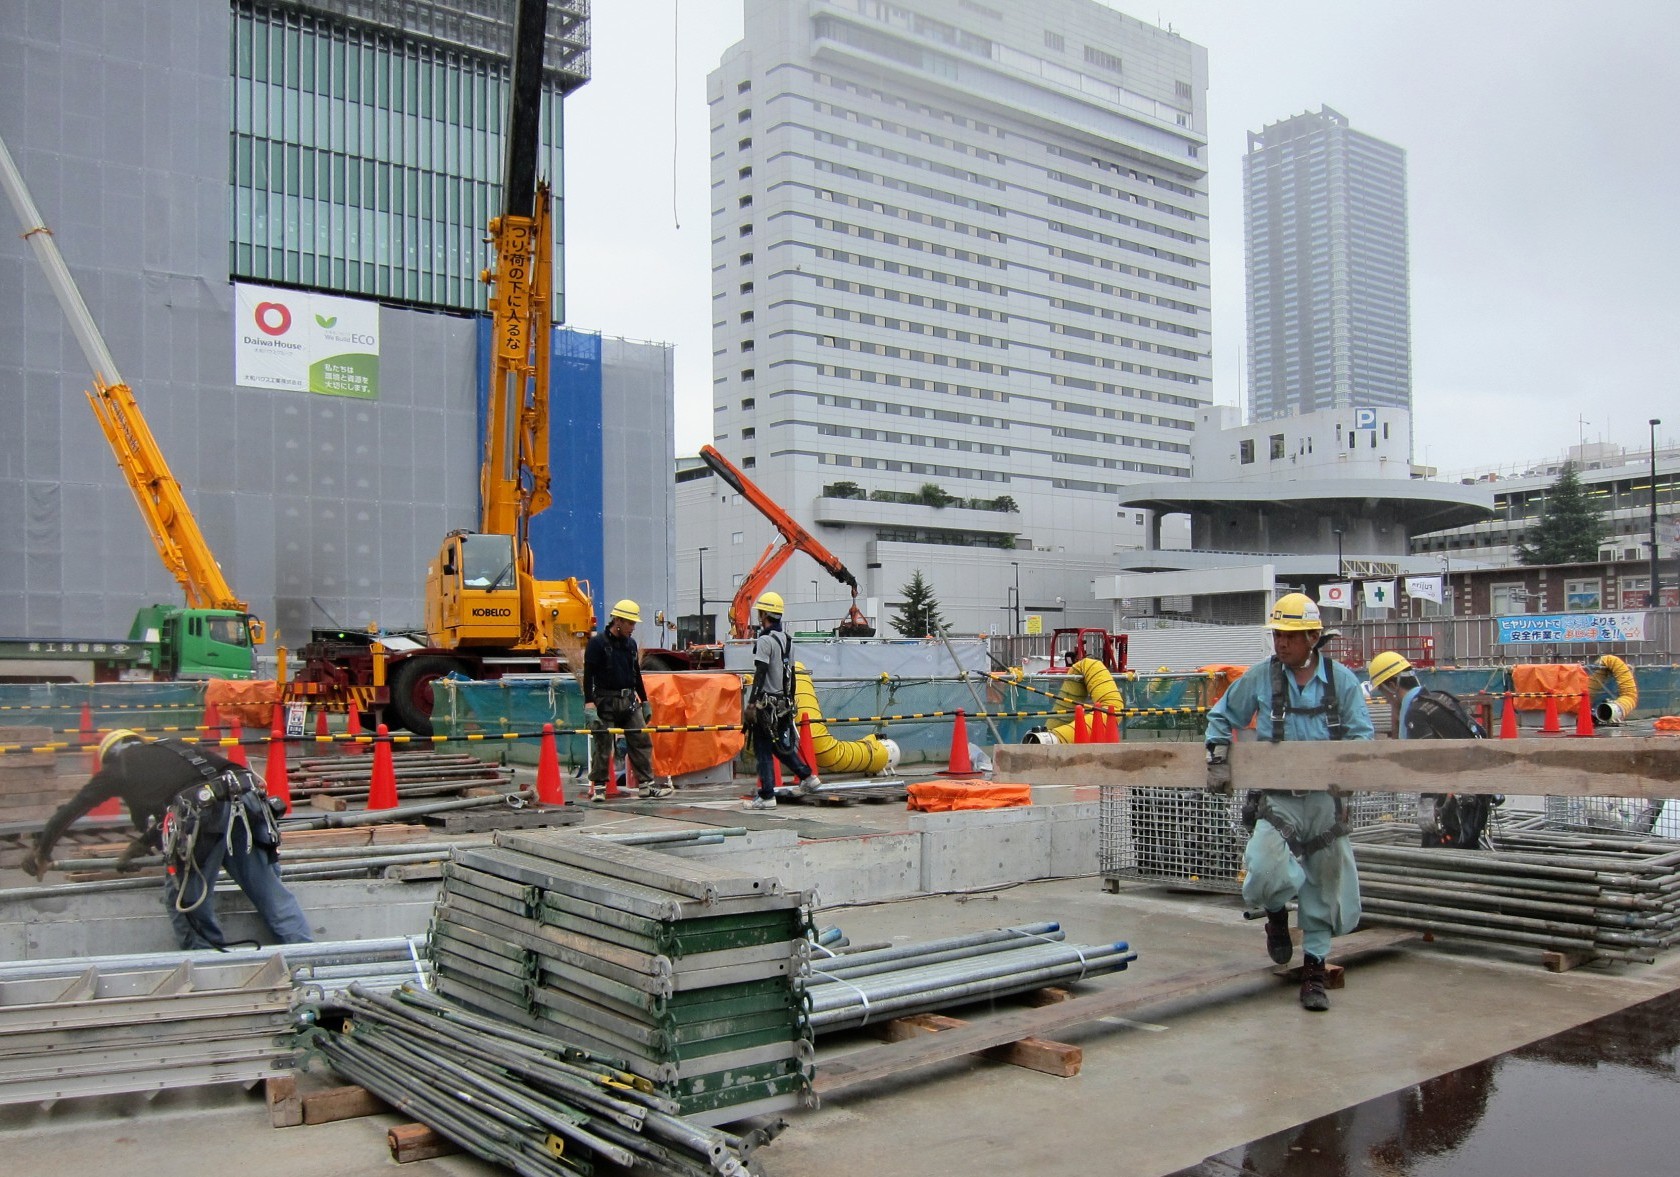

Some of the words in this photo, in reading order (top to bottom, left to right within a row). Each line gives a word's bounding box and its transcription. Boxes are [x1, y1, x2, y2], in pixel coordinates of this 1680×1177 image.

[506, 227, 526, 349] つり荷の下に入るな
[244, 336, 273, 347] Daiwa
[274, 340, 303, 351] House
[352, 333, 375, 346] ECO
[325, 364, 354, 374] 私たちは
[1357, 410, 1375, 428] P
[472, 608, 511, 617] KOBELCO
